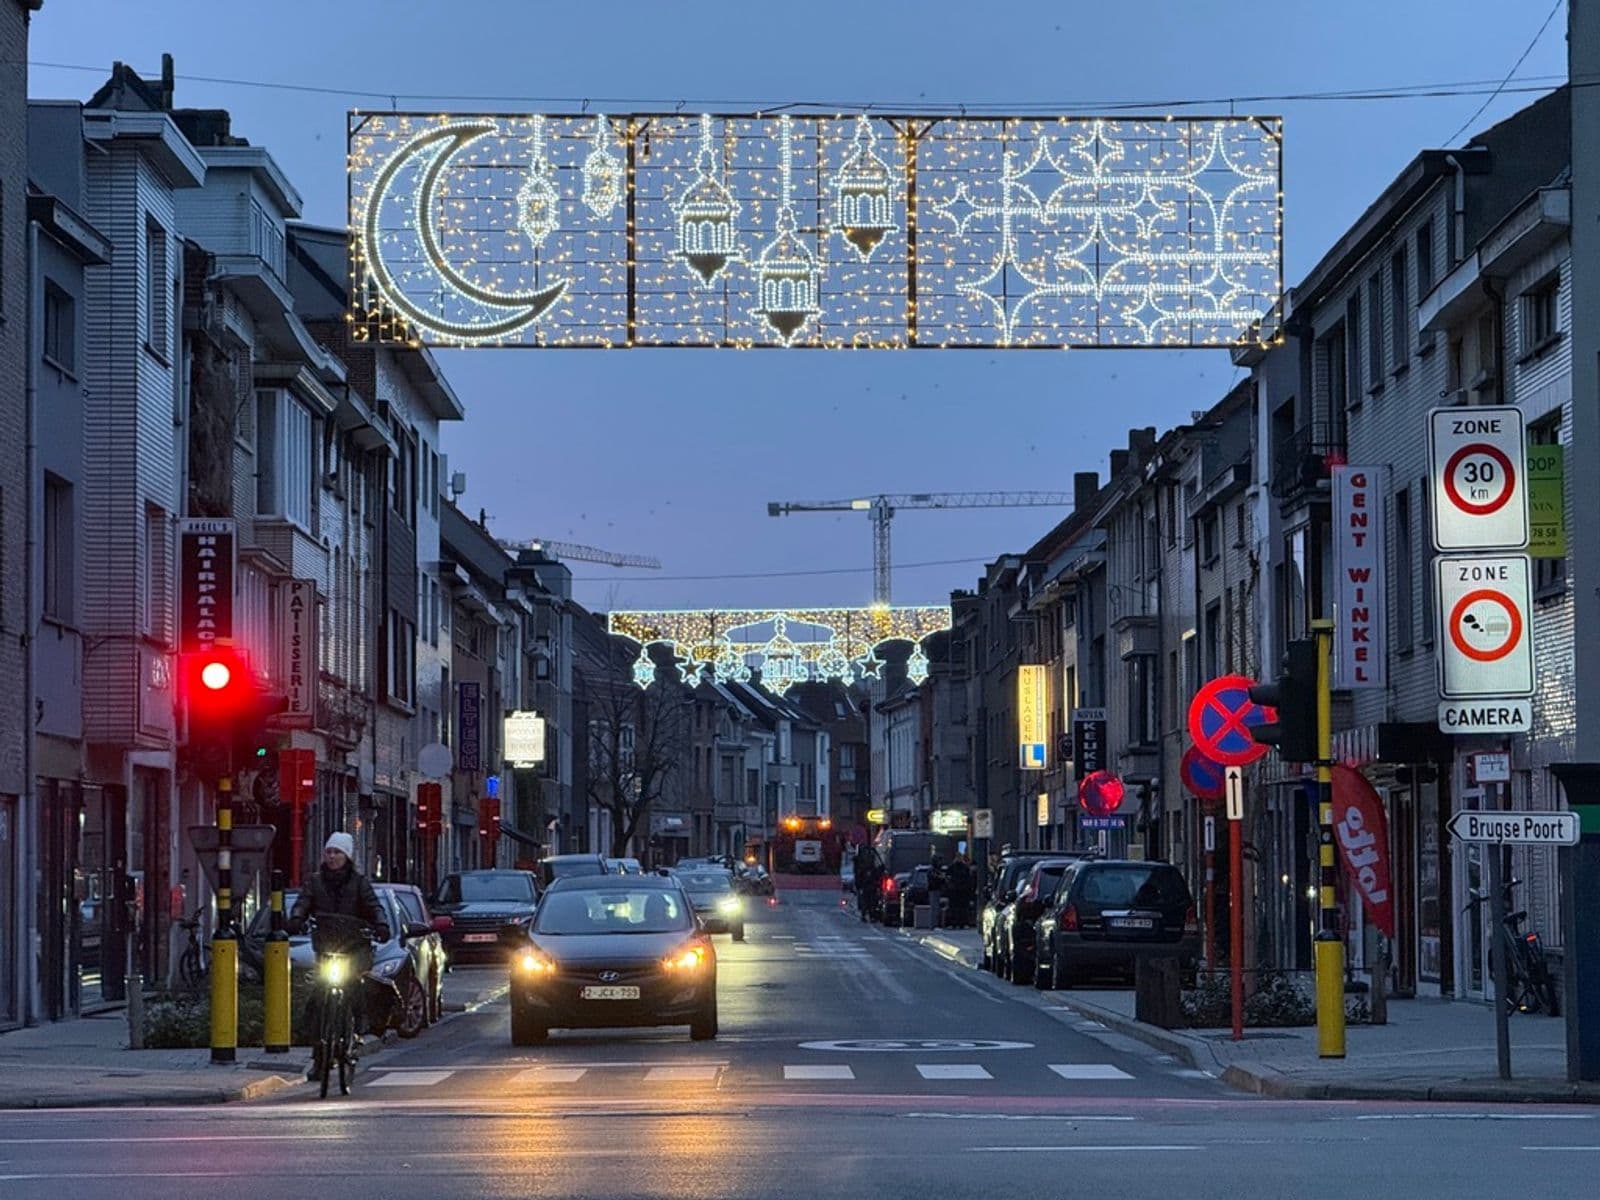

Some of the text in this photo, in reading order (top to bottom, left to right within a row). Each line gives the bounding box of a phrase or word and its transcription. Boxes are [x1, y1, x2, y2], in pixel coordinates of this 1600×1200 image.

[1452, 419, 1501, 434] ZONE
[1464, 462, 1494, 483] 30
[1528, 457, 1556, 472] OOP
[1470, 486, 1489, 499] km
[1348, 473, 1370, 682] GENT WINKEL
[1459, 566, 1508, 581] ZONE
[290, 583, 302, 712] PATISSERIE
[1446, 707, 1523, 726] CAMERA
[1083, 722, 1097, 777] KEUKE
[1470, 817, 1564, 843] Brugse Poort
